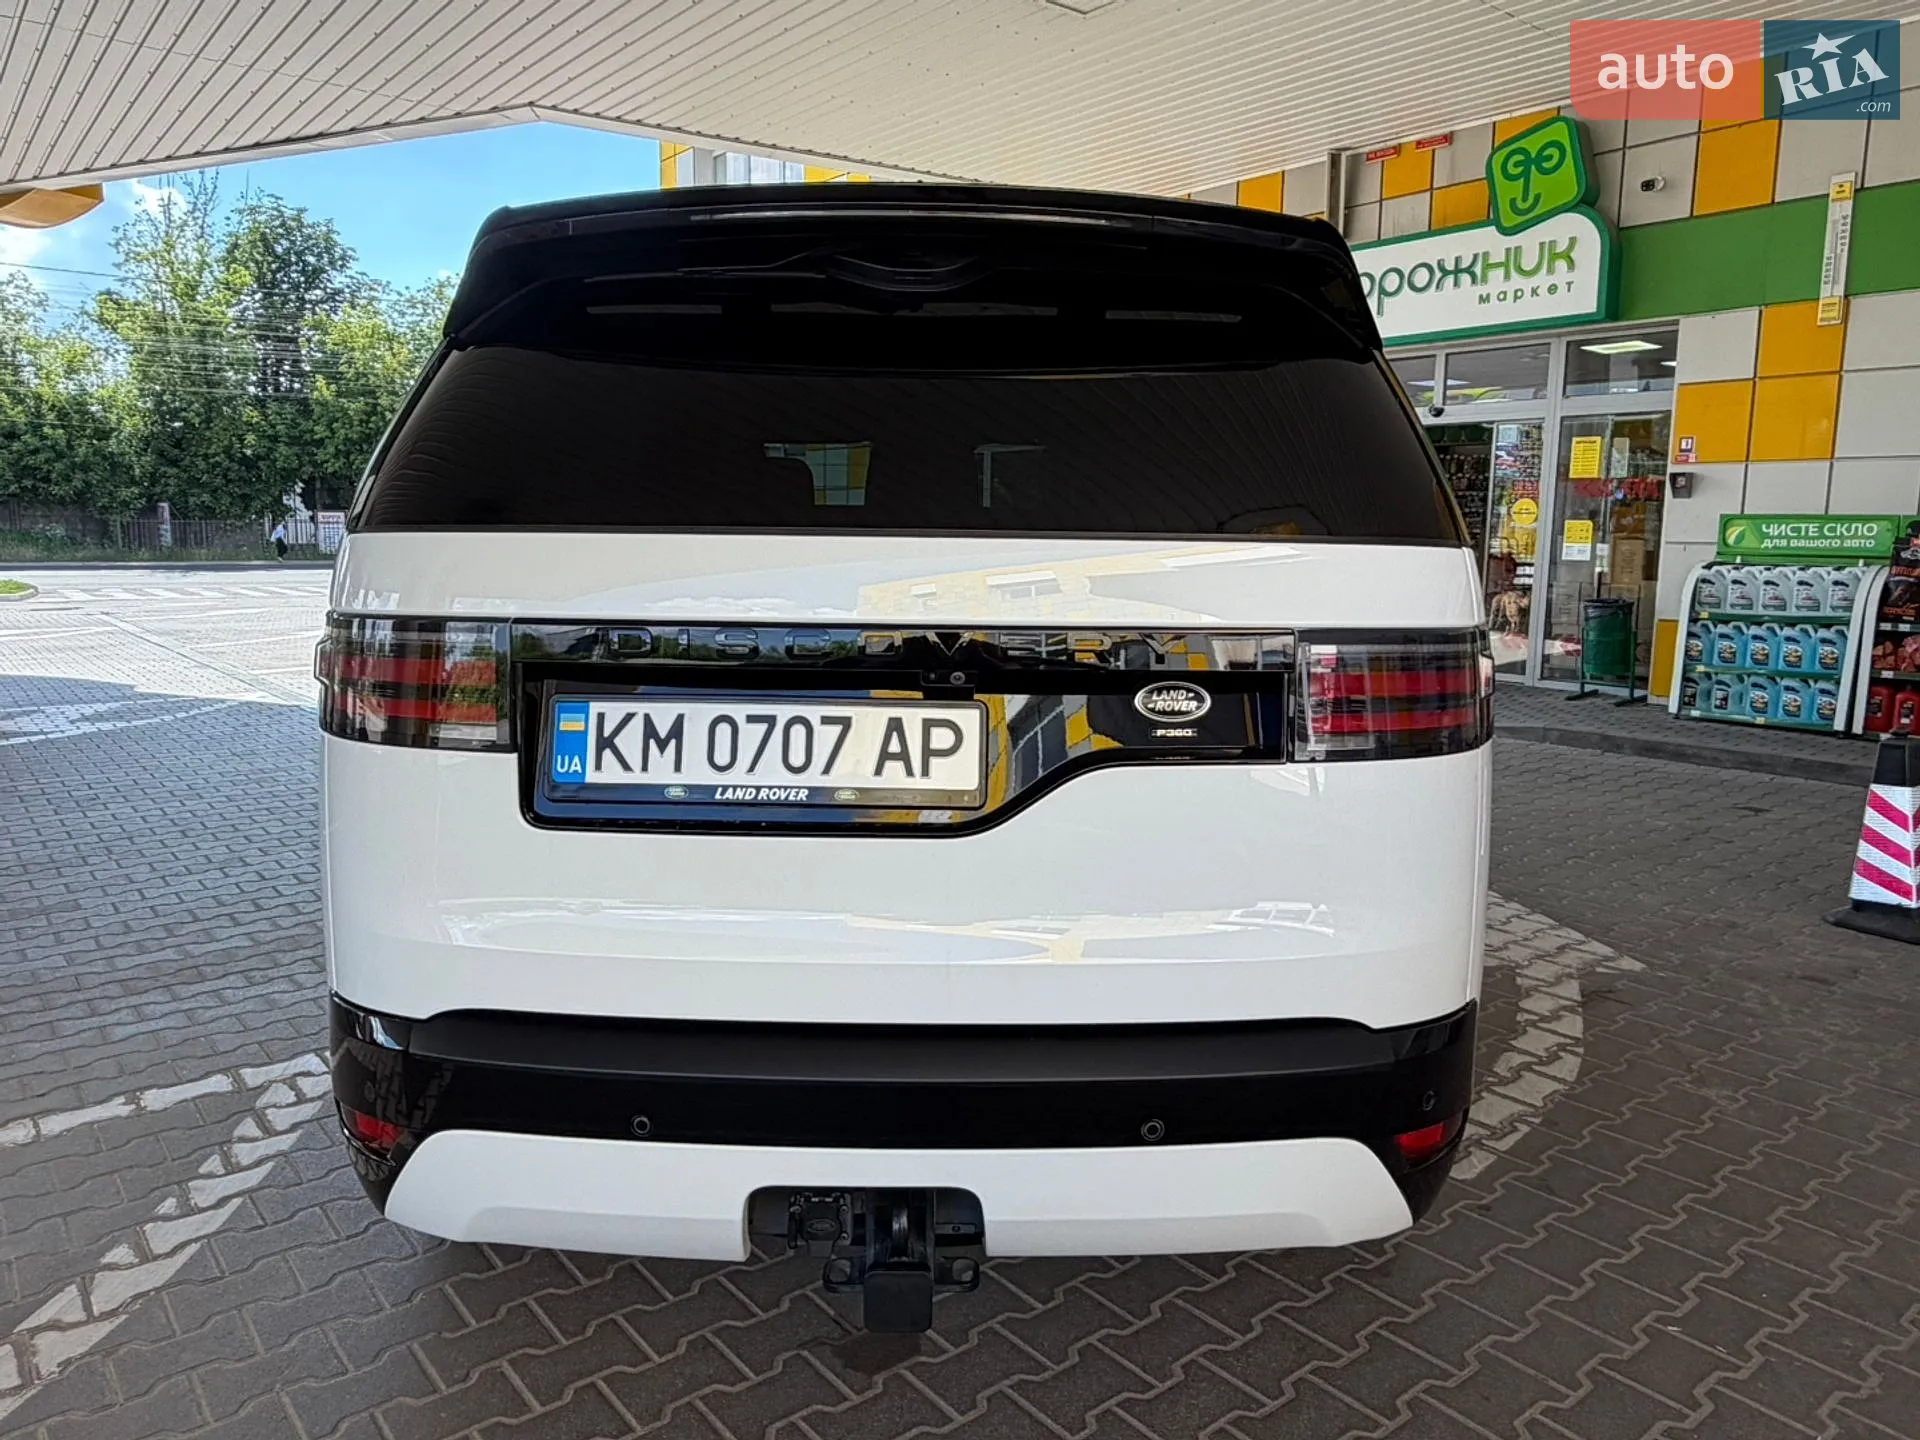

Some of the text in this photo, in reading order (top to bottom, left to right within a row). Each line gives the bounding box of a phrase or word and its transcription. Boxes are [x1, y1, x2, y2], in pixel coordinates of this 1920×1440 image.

[1478, 280, 1575, 305] маркет
[1761, 523, 1878, 536] ЧИСТЕ СКЛО
[1761, 538, 1875, 549] для вашого авто
[1152, 689, 1188, 700] LAND
[1154, 701, 1198, 712] ROVER
[594, 711, 965, 779] KM 0707 AP
[556, 755, 582, 773] UA
[714, 786, 809, 802] LAND ROVER
